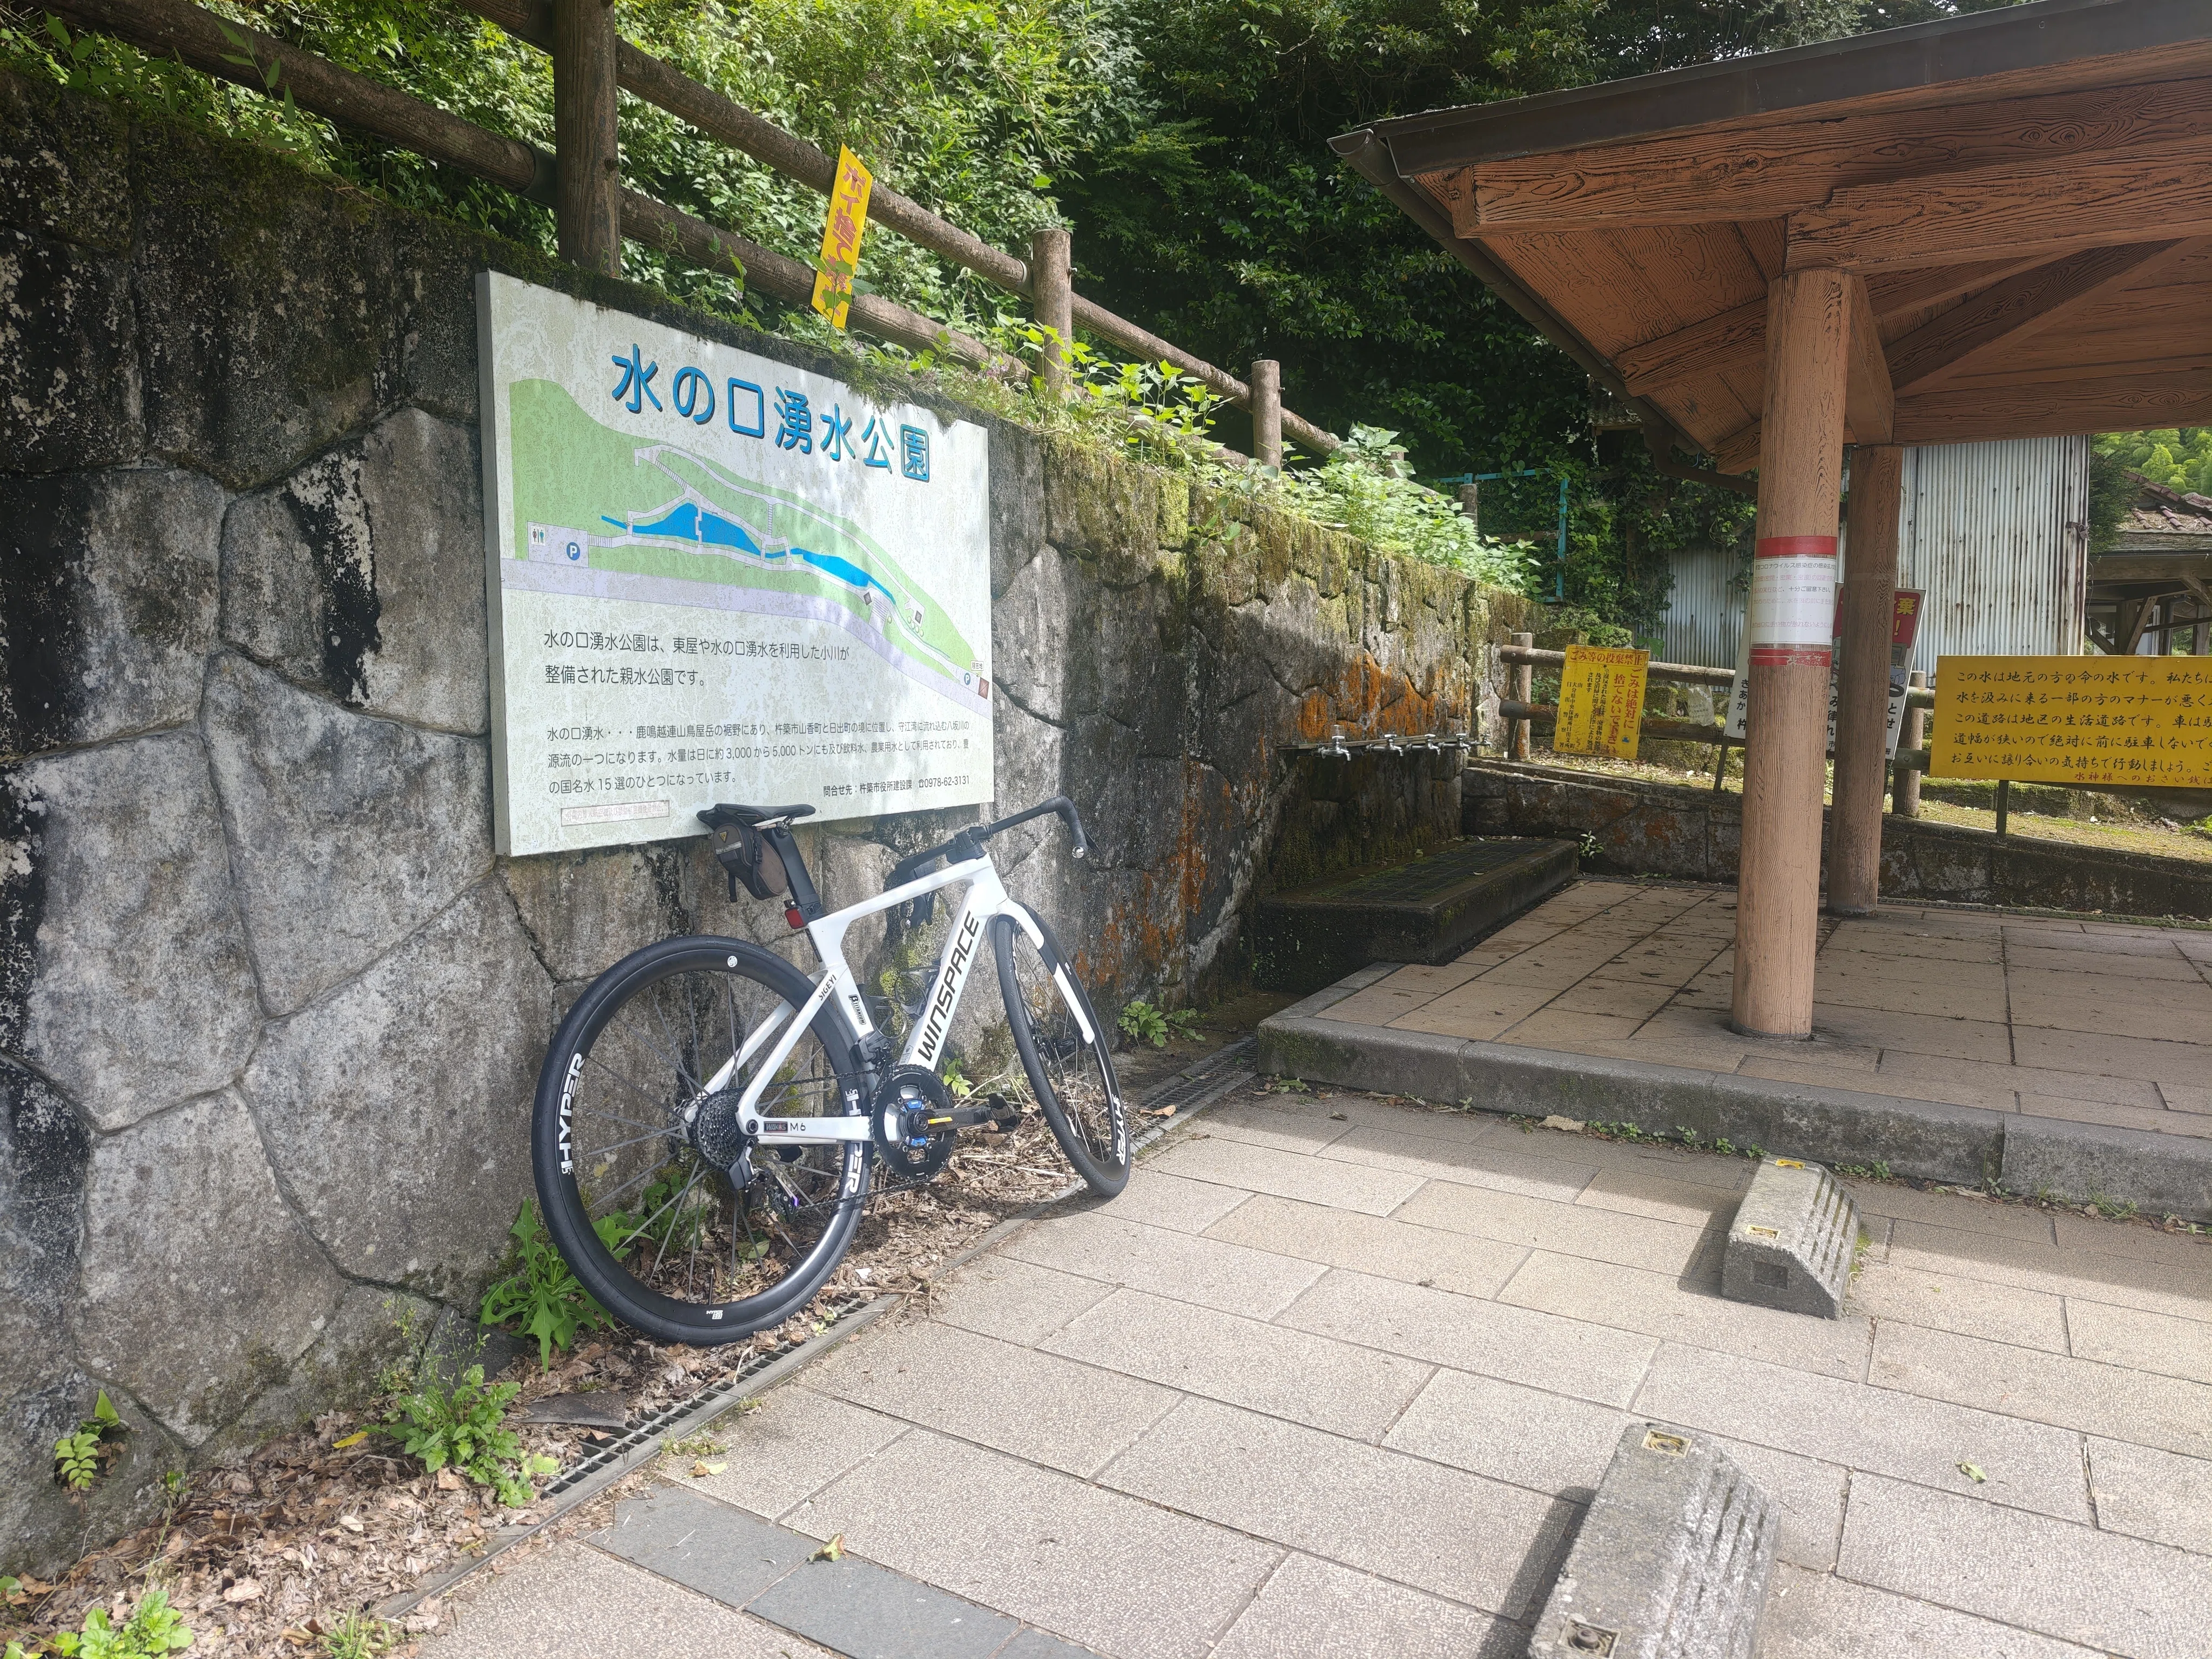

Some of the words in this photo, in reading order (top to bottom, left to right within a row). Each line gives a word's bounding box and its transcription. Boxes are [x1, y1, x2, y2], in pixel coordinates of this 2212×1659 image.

[611, 342, 930, 483] 水の口湧水公園
[544, 629, 849, 661] 水の口湧水公園は、東屋や水の口湧水を利用した小川が
[545, 664, 704, 686] 整備された親水公園です。
[1570, 650, 1642, 666] ごみ等の投棄禁止
[1607, 673, 1626, 754] 捨てないで下さい
[1623, 667, 1642, 730] ごみは絶対に
[818, 974, 837, 1001] SIGEYI
[918, 910, 980, 1062] WINSPACE
[558, 1052, 586, 1168] HYPER
[790, 1122, 806, 1131] M6
[1115, 1099, 1127, 1165] HYPER
[844, 1093, 863, 1193] HPER
